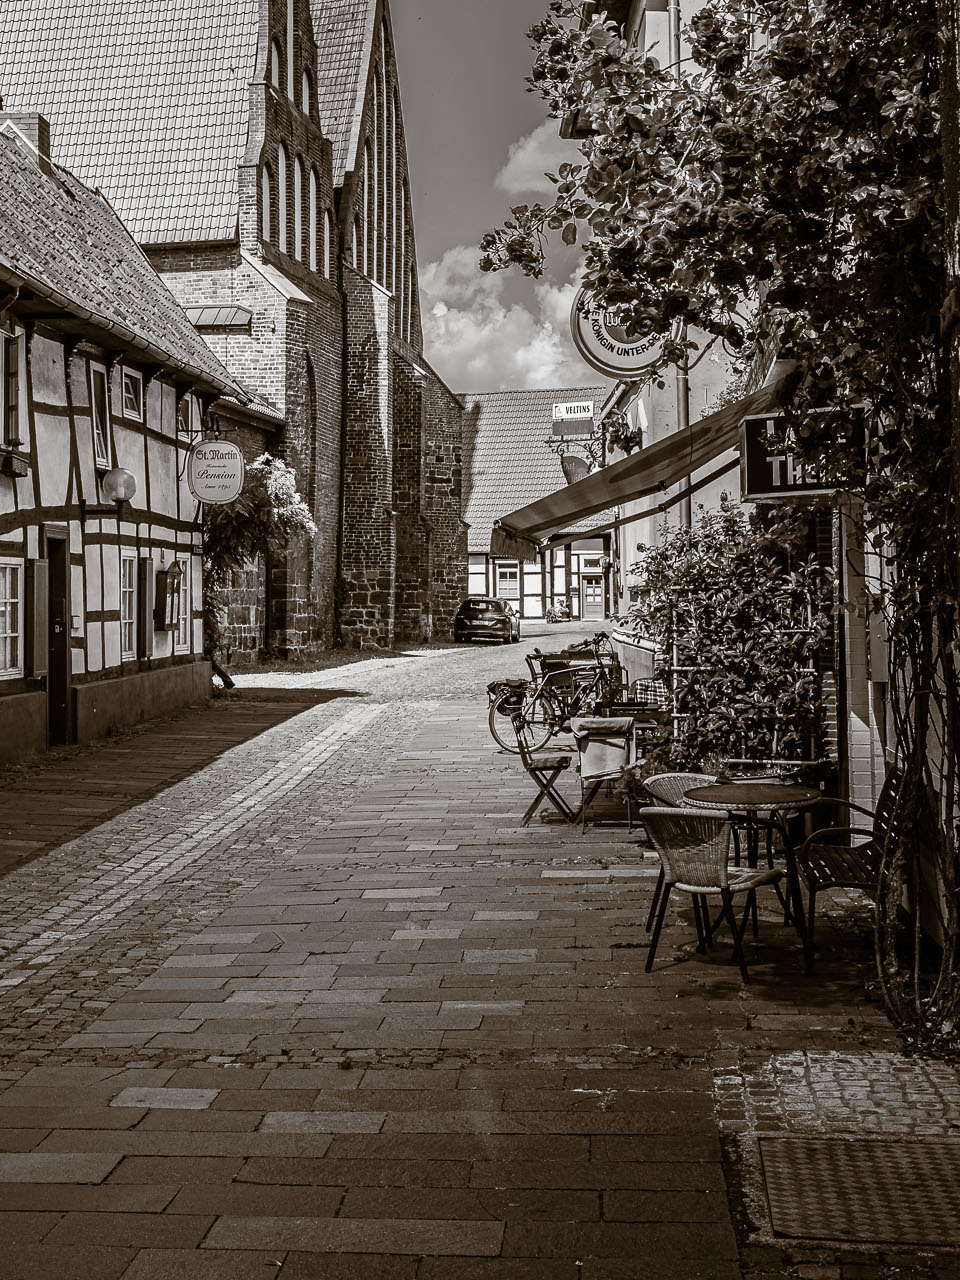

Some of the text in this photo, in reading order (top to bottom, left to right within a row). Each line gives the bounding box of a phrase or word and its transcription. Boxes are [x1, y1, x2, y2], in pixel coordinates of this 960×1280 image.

[591, 318, 616, 353] KÖNIGIN
[616, 343, 649, 357] UNTER
[565, 404, 591, 415] VELTINS
[209, 449, 238, 460] Martin
[196, 469, 236, 480] Pension
